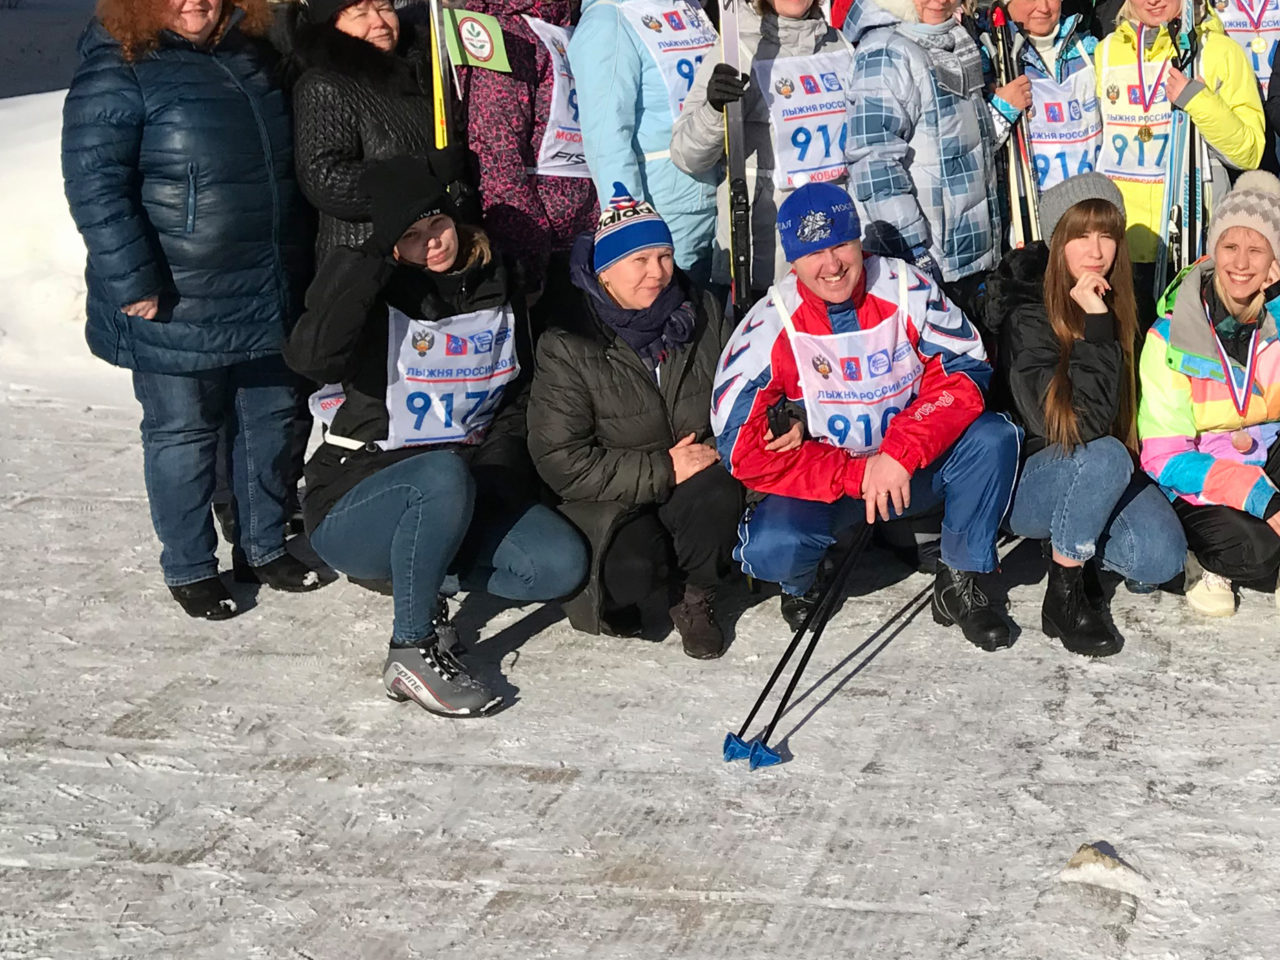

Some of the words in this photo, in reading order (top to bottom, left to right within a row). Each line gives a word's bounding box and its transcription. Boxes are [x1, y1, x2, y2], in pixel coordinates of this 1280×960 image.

[782, 104, 818, 117] ЛЫЖНЯ
[406, 367, 453, 378] ЛЫЖНЯ
[817, 390, 858, 400] ЛЫЖНЯ
[901, 364, 922, 385] 2013
[827, 392, 918, 447] 910
